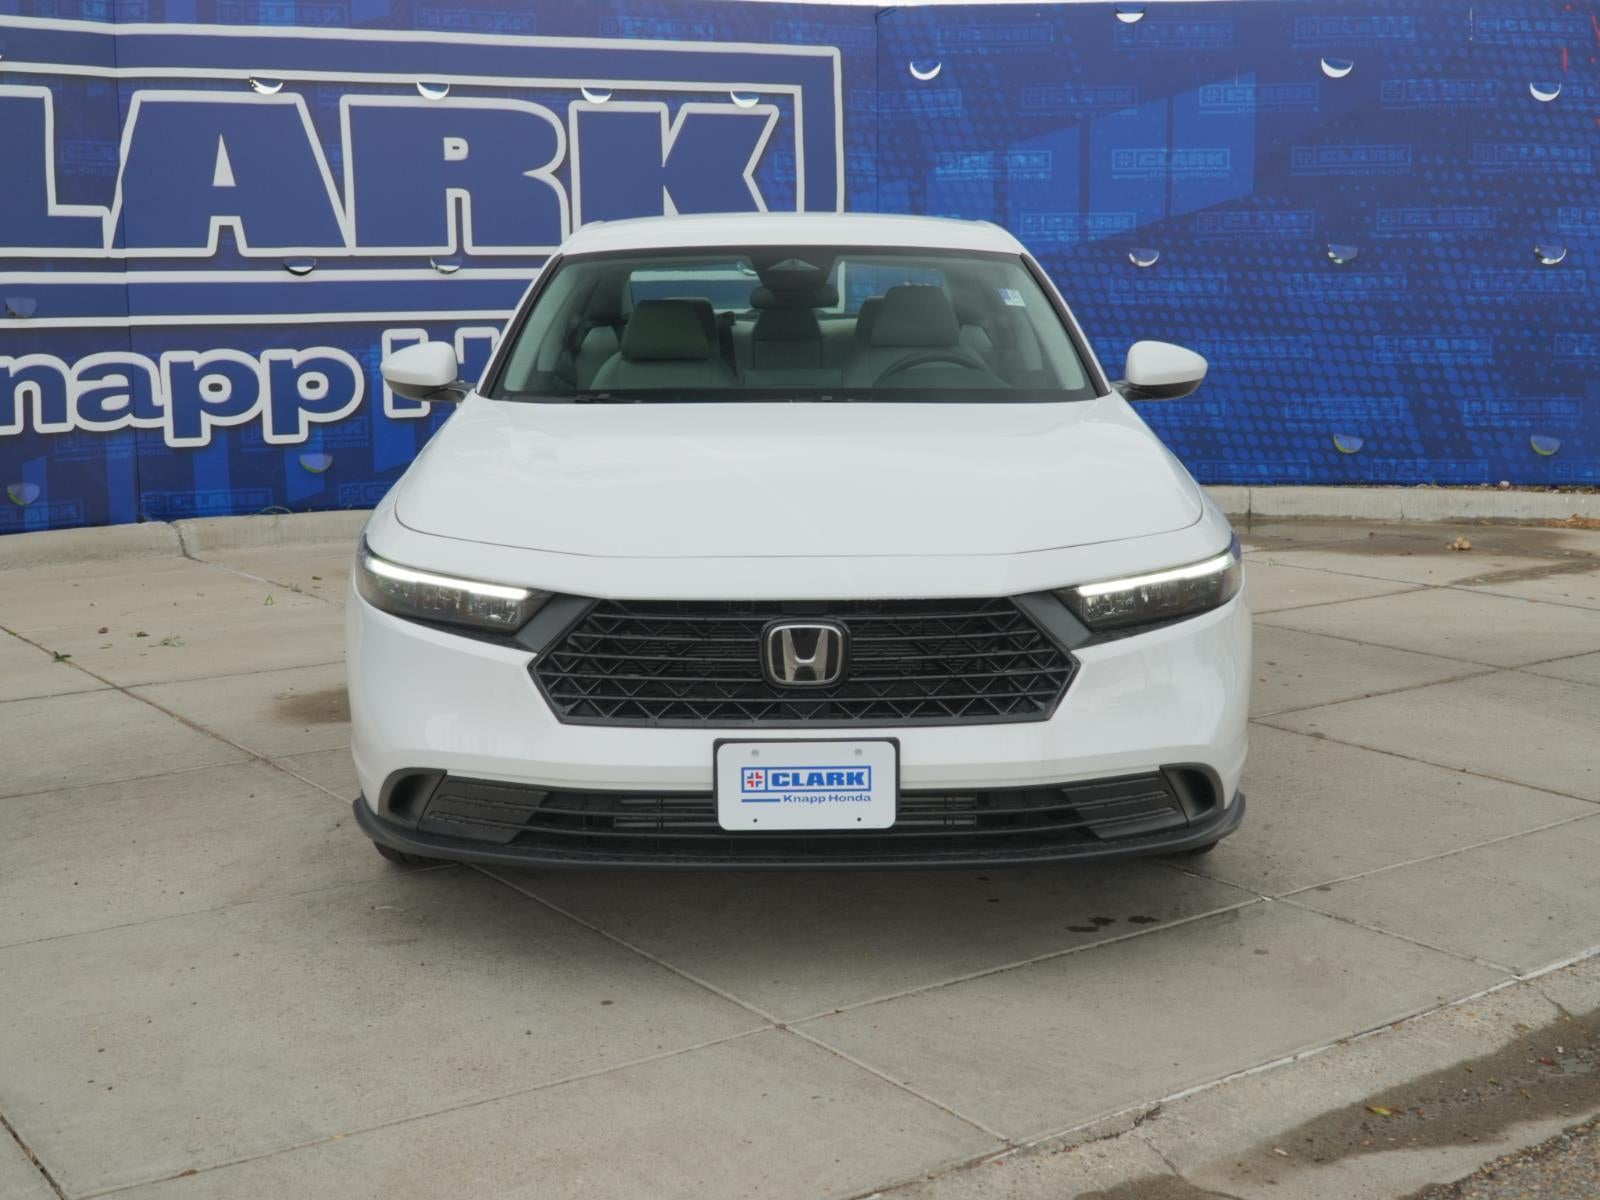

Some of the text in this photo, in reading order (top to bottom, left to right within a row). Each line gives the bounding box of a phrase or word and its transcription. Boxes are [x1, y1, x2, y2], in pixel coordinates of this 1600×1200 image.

[771, 771, 865, 787] CLARK
[783, 793, 871, 805] Knapp Honda
